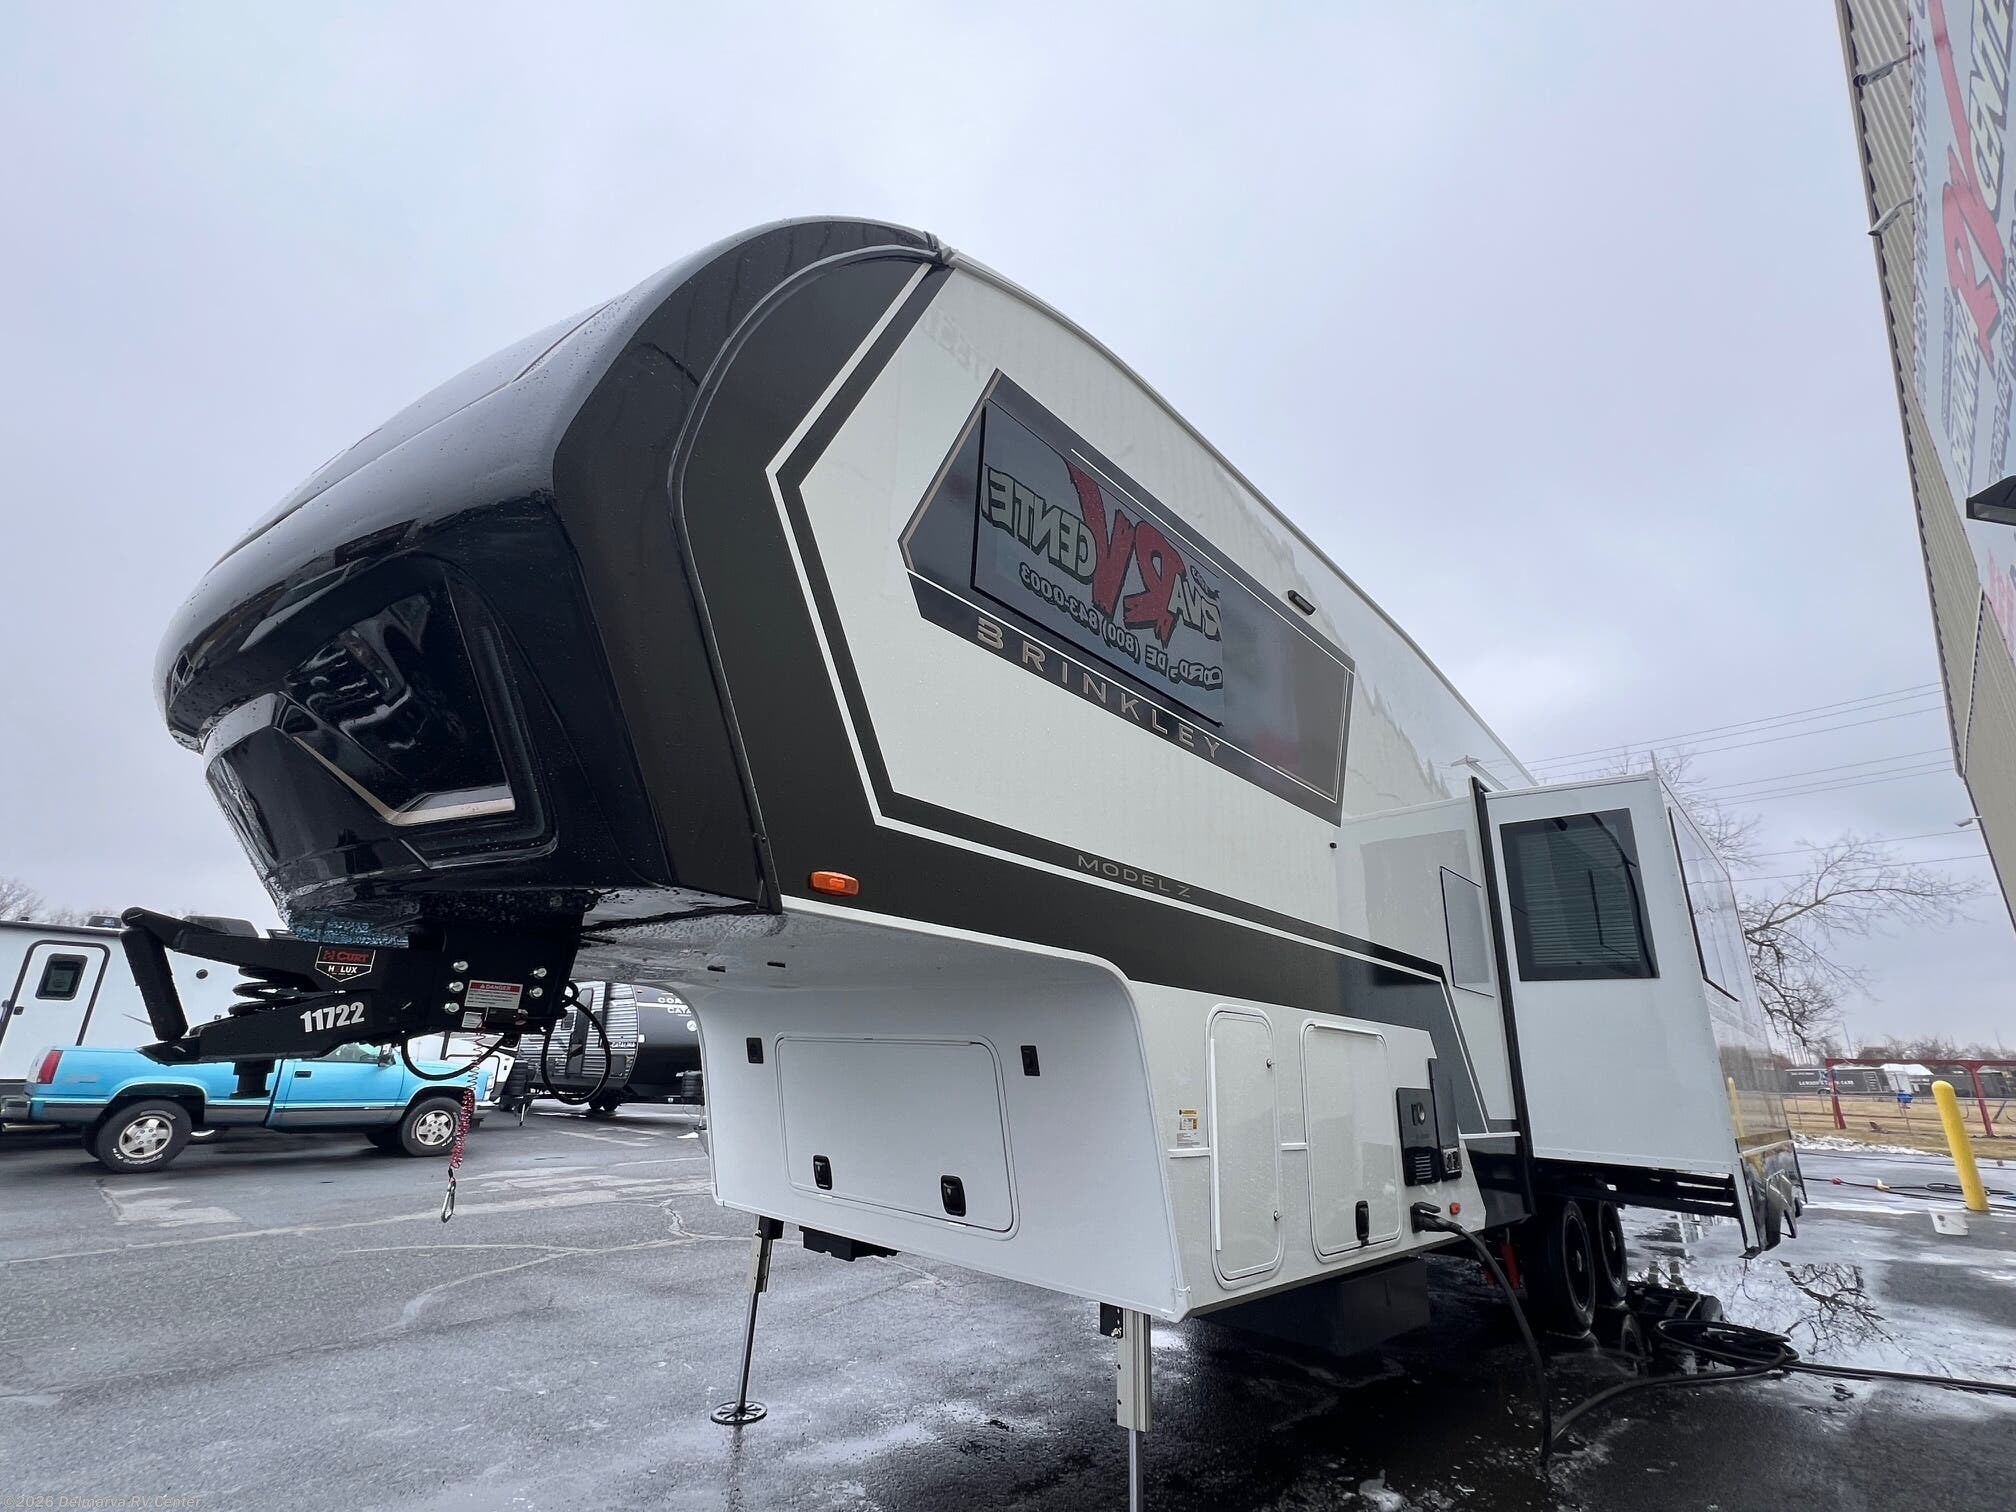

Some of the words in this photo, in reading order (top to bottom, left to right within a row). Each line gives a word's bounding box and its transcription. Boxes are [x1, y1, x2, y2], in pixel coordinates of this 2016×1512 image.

[1911, 27, 1927, 146] HERE
[1914, 183, 1927, 289] PRICE
[1927, 0, 2006, 380] RV
[976, 616, 1221, 759] BRINKLEY
[1078, 854, 1171, 893] MODEL
[1176, 884, 1192, 899] Z
[336, 952, 369, 962] CURT
[300, 1001, 365, 1033] 11722
